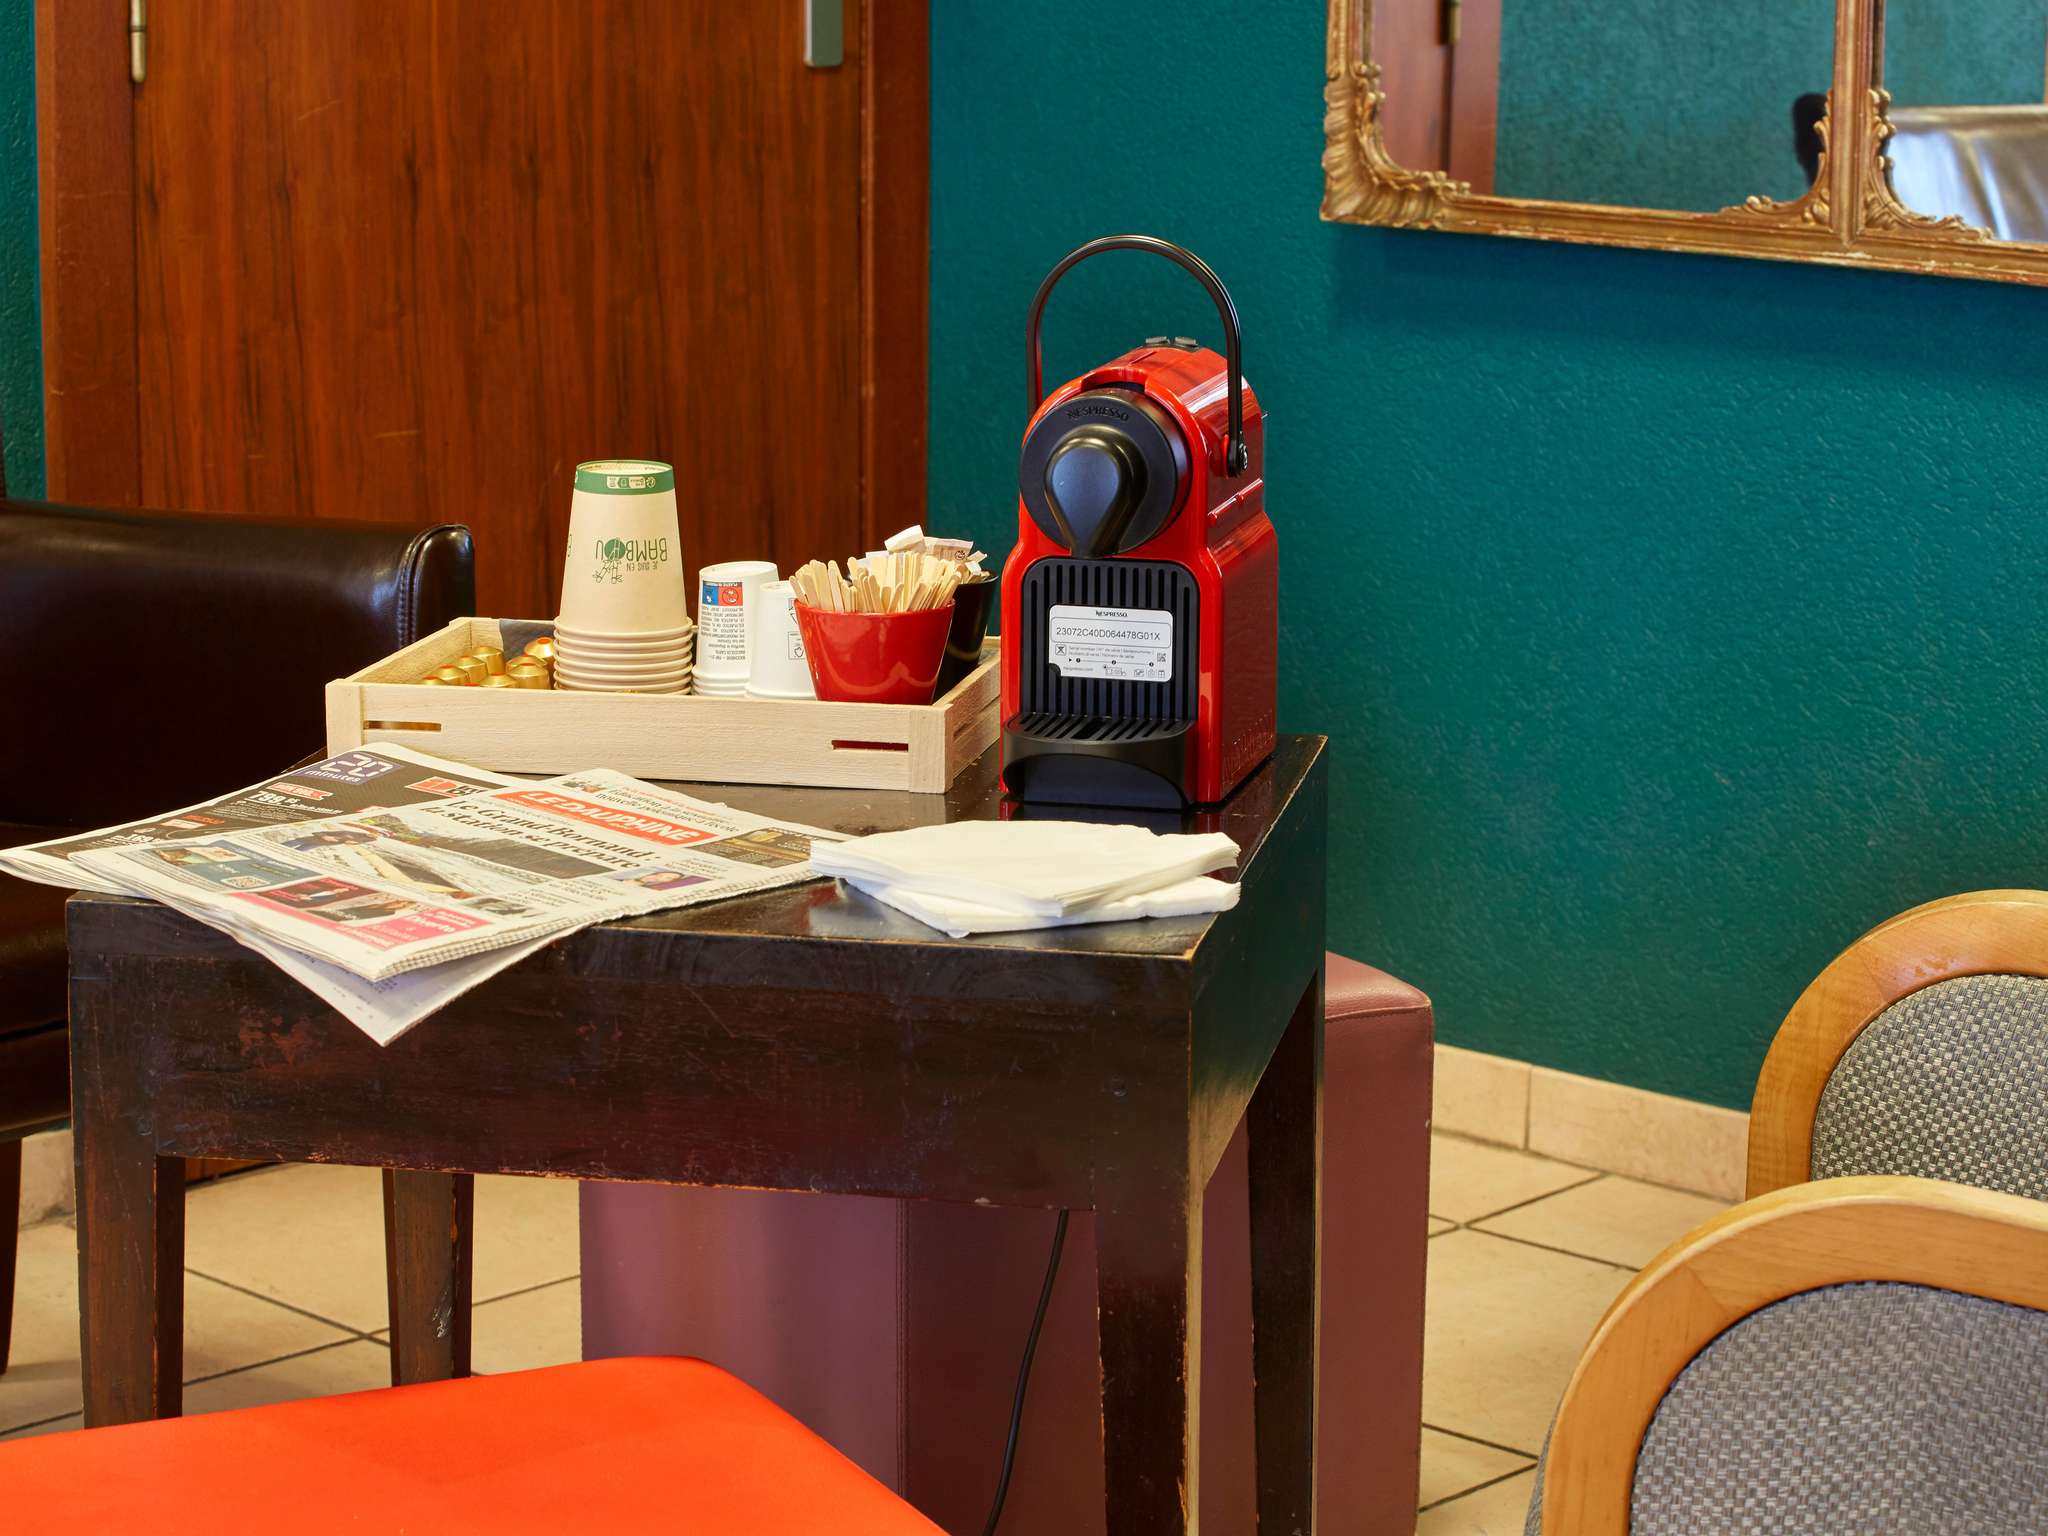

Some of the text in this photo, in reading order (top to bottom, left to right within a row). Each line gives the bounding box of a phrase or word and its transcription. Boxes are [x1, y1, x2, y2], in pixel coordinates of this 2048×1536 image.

[1095, 610, 1128, 618] NESPRESSO
[319, 753, 394, 778] 20
[304, 769, 361, 783] minutes
[440, 811, 523, 836] station
